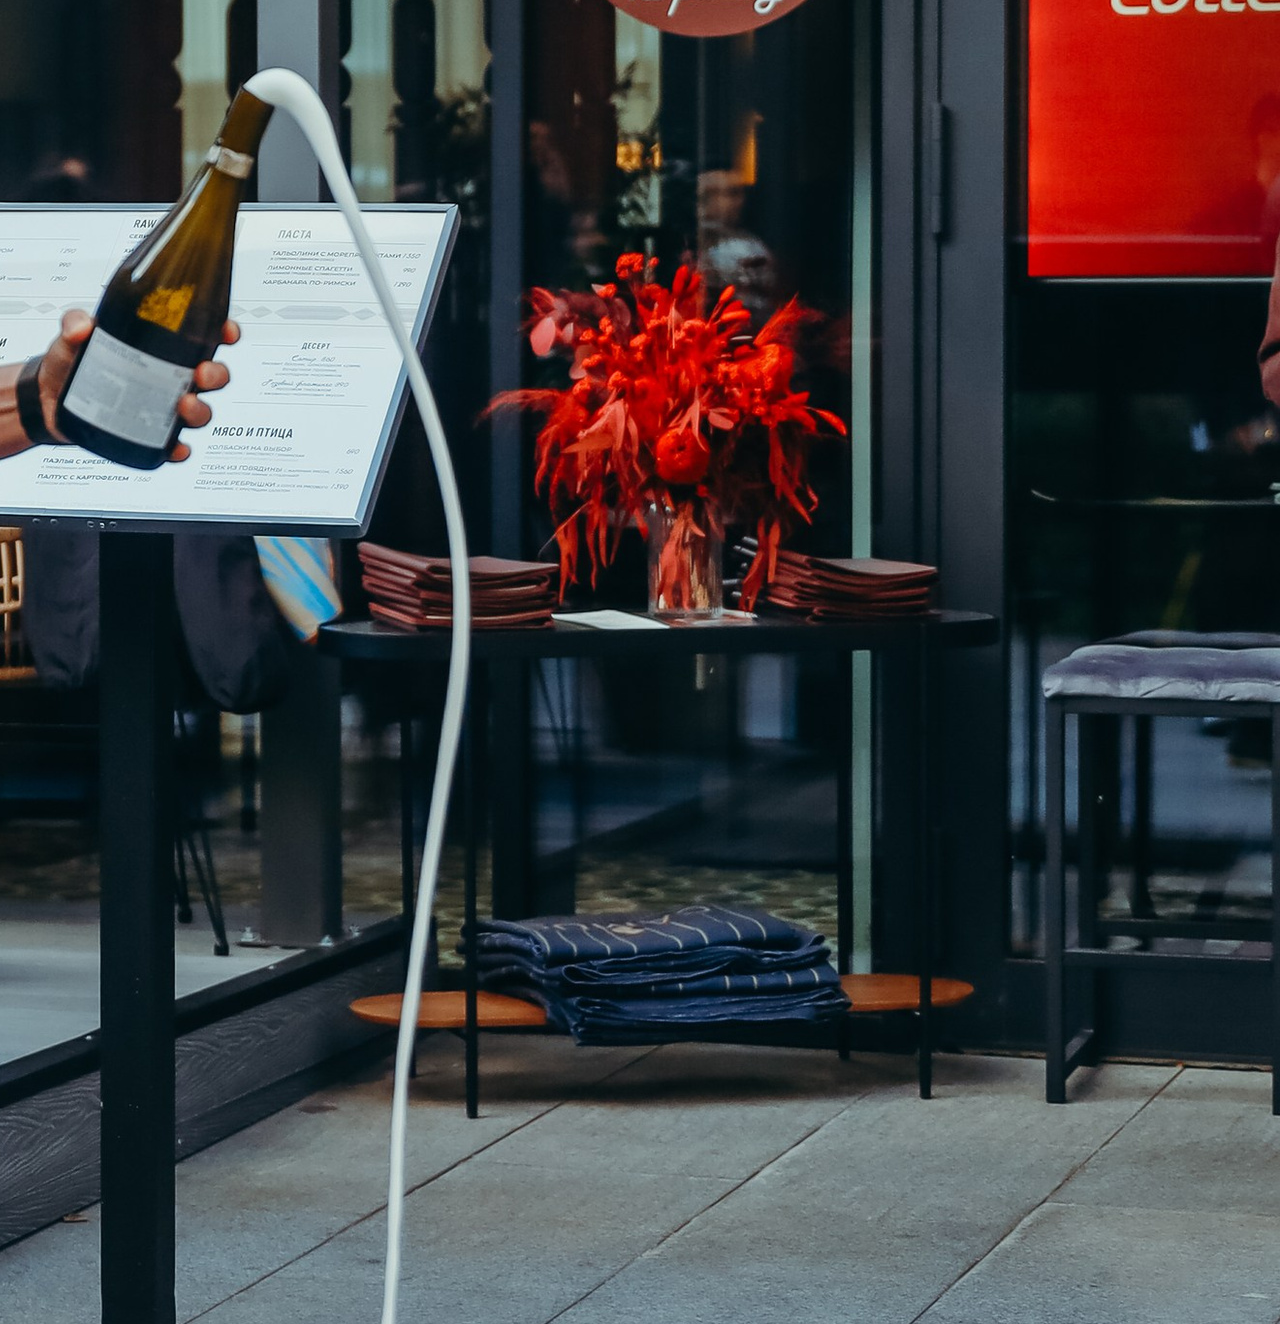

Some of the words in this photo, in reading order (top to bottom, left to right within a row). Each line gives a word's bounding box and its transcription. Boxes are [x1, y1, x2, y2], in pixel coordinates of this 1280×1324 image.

[133, 219, 158, 228] RAW
[277, 229, 312, 239] ПАСТА
[301, 342, 331, 350] ДЕСЕРТ
[211, 426, 244, 437] МЯСО
[245, 427, 255, 437] И
[255, 427, 293, 439] ПТИЦА
